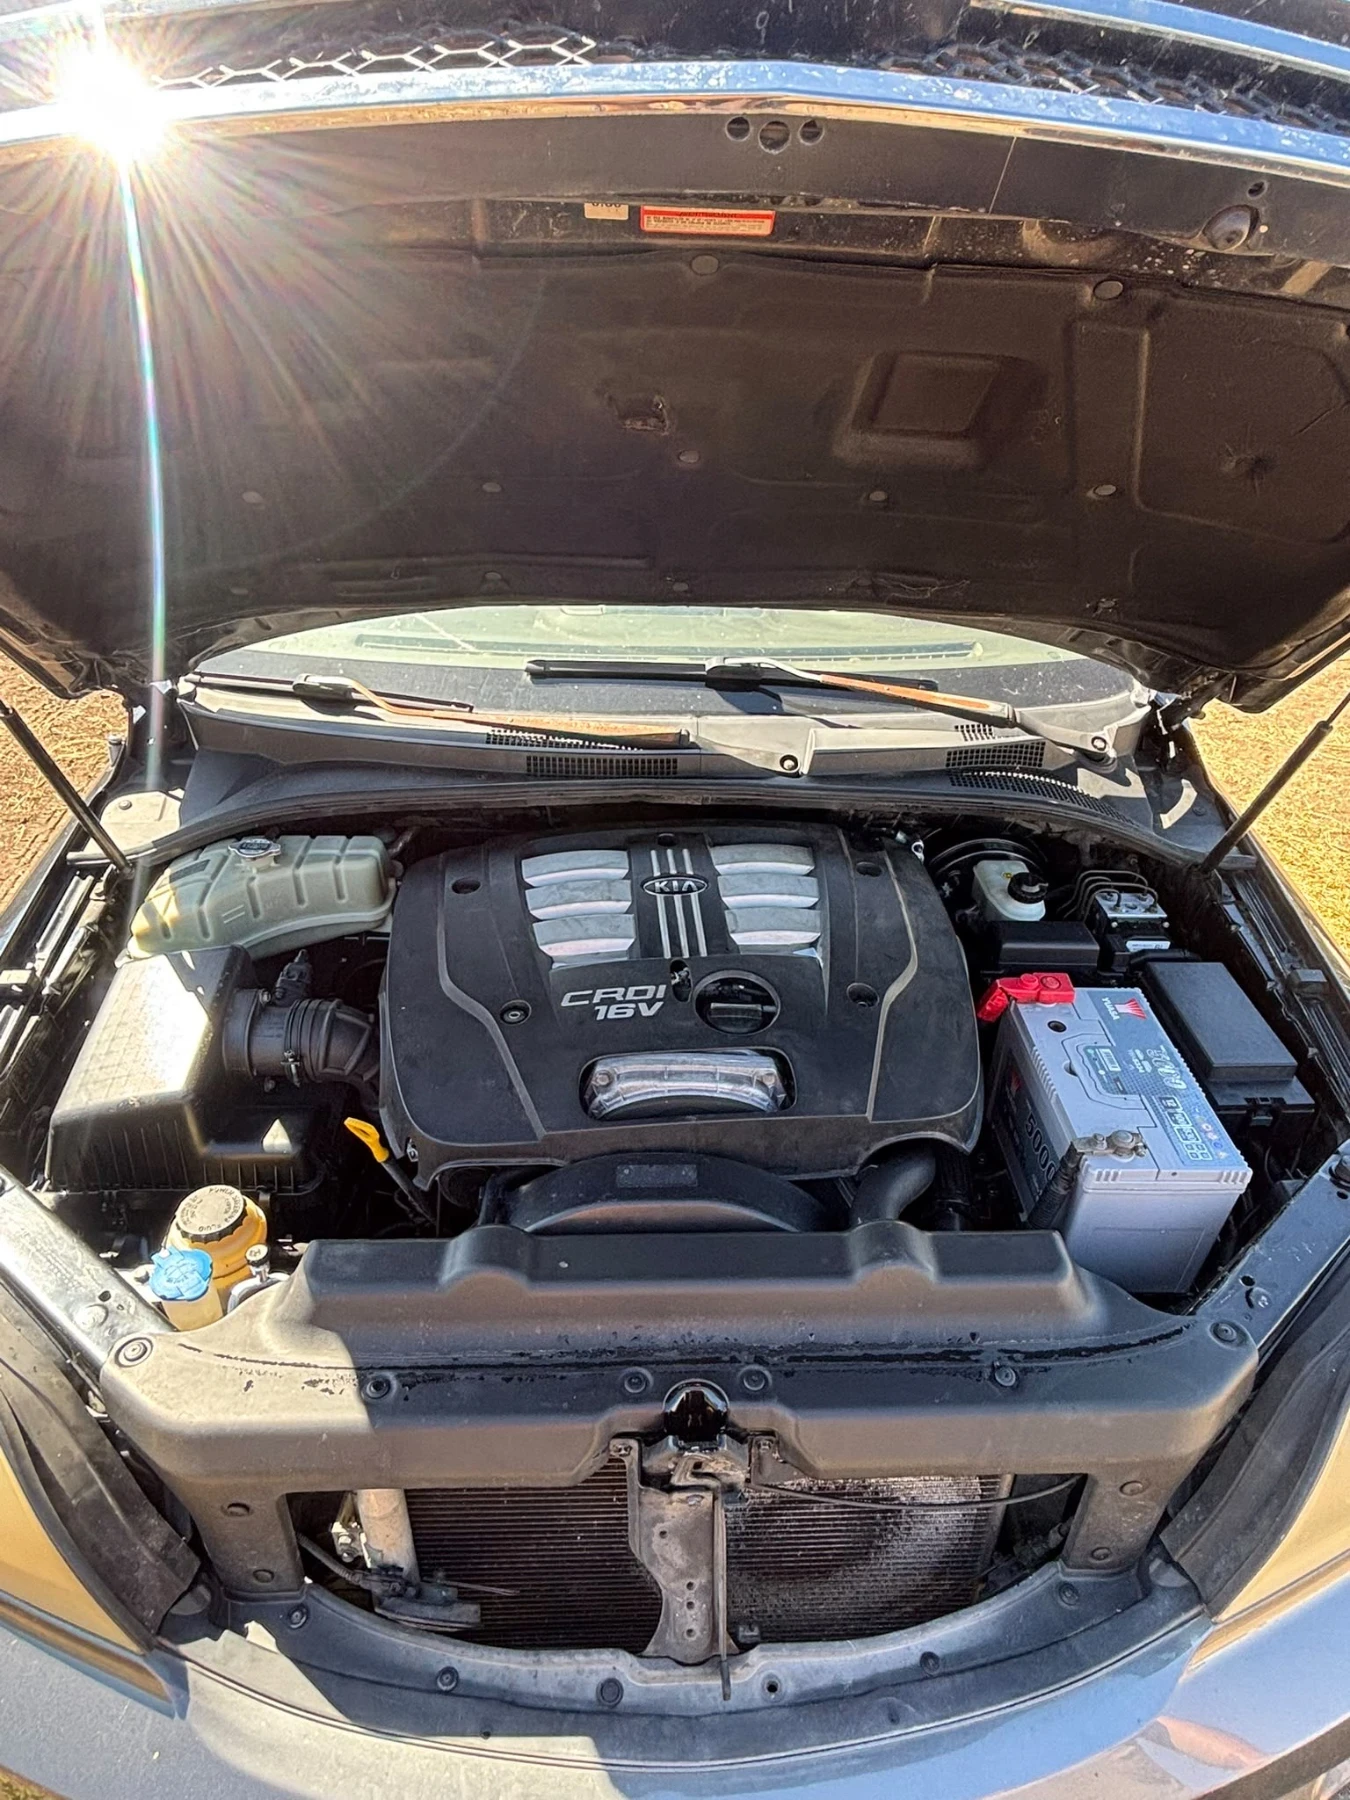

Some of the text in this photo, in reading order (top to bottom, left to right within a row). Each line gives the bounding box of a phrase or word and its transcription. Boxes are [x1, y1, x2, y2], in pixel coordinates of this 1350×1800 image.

[655, 880, 698, 892] KIA
[561, 984, 667, 1007] CRDI
[594, 1001, 664, 1020] 16V
[1102, 997, 1121, 1021] YUASA
